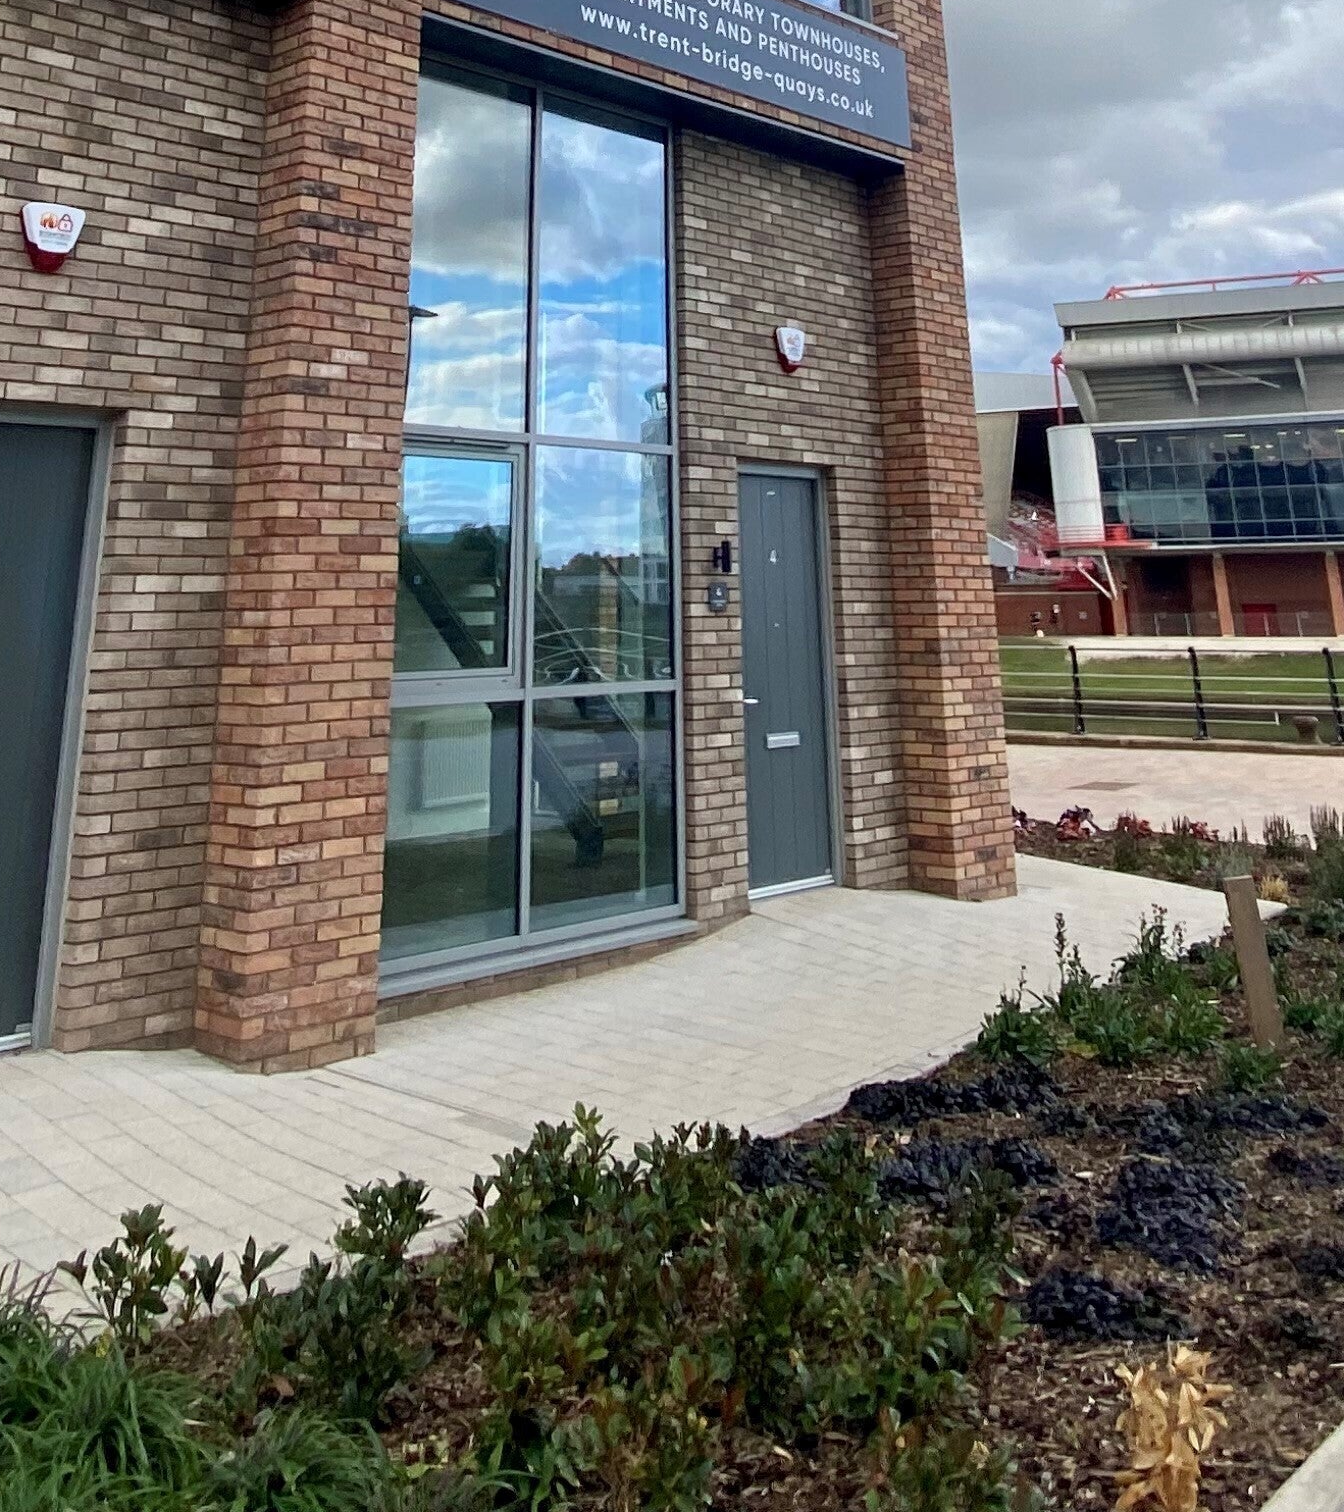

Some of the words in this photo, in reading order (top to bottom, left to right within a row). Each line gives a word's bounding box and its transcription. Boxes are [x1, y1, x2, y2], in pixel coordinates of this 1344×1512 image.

[580, 4, 875, 119] www.trent-bridge-quays.co.uk
[715, 17, 752, 45] AND
[758, 33, 862, 85] PENTHOUSES
[771, 12, 886, 73] TOWNHOUSES,
[769, 549, 777, 565] 4
